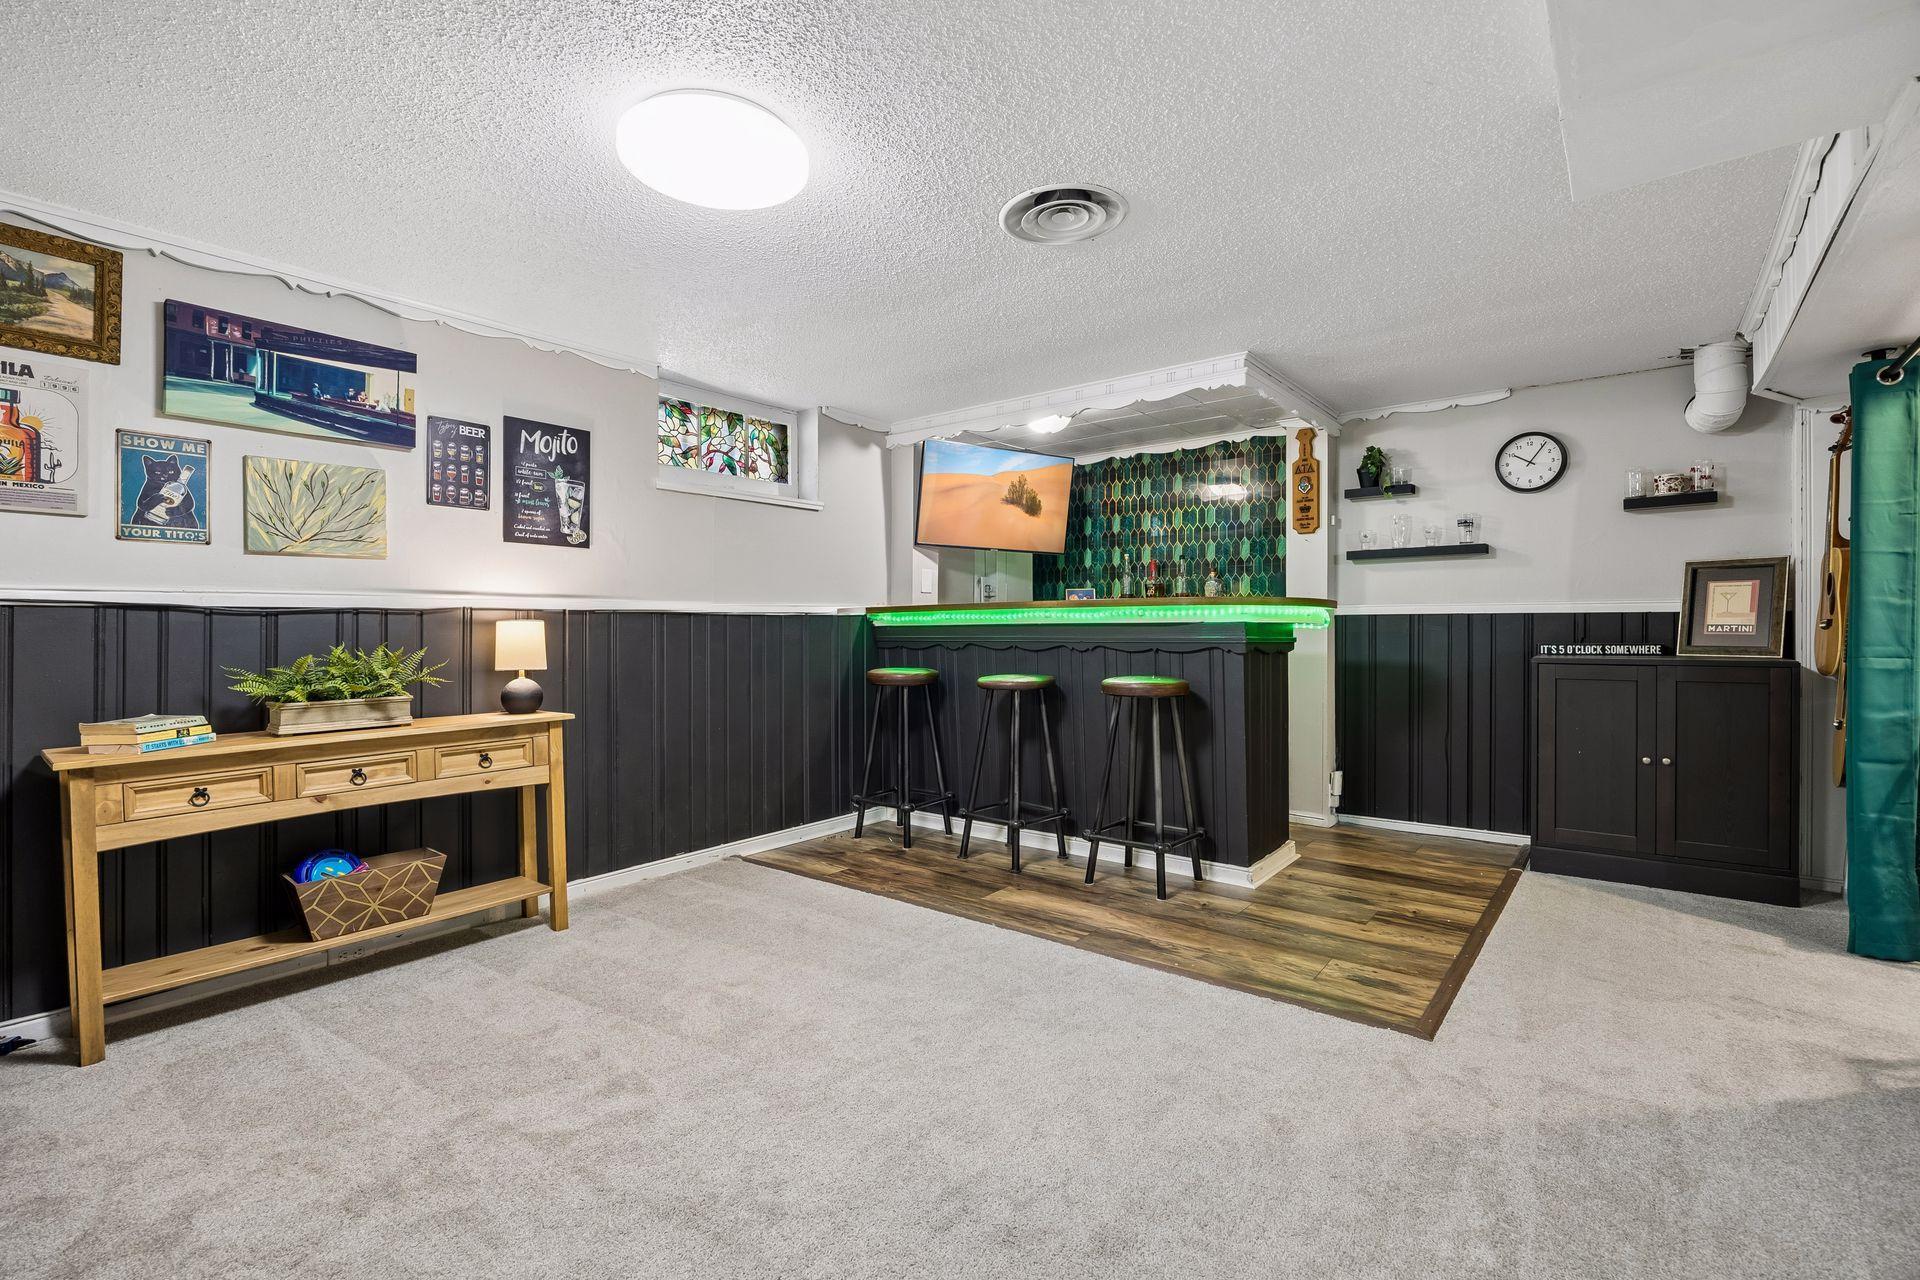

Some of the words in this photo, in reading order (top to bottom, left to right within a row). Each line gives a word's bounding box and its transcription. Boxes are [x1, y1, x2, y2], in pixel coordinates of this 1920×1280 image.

[459, 425, 486, 438] BEER
[122, 434, 175, 450] SHOW
[182, 442, 205, 454] ME
[520, 429, 578, 462] Mojito
[122, 527, 162, 538] YOUR
[164, 530, 206, 540] TITO'S
[1540, 645, 1557, 654] IT'S
[1559, 645, 1565, 654] 5
[1566, 645, 1603, 654] O'CLOCK
[1605, 645, 1662, 654] SOMEWHERE
